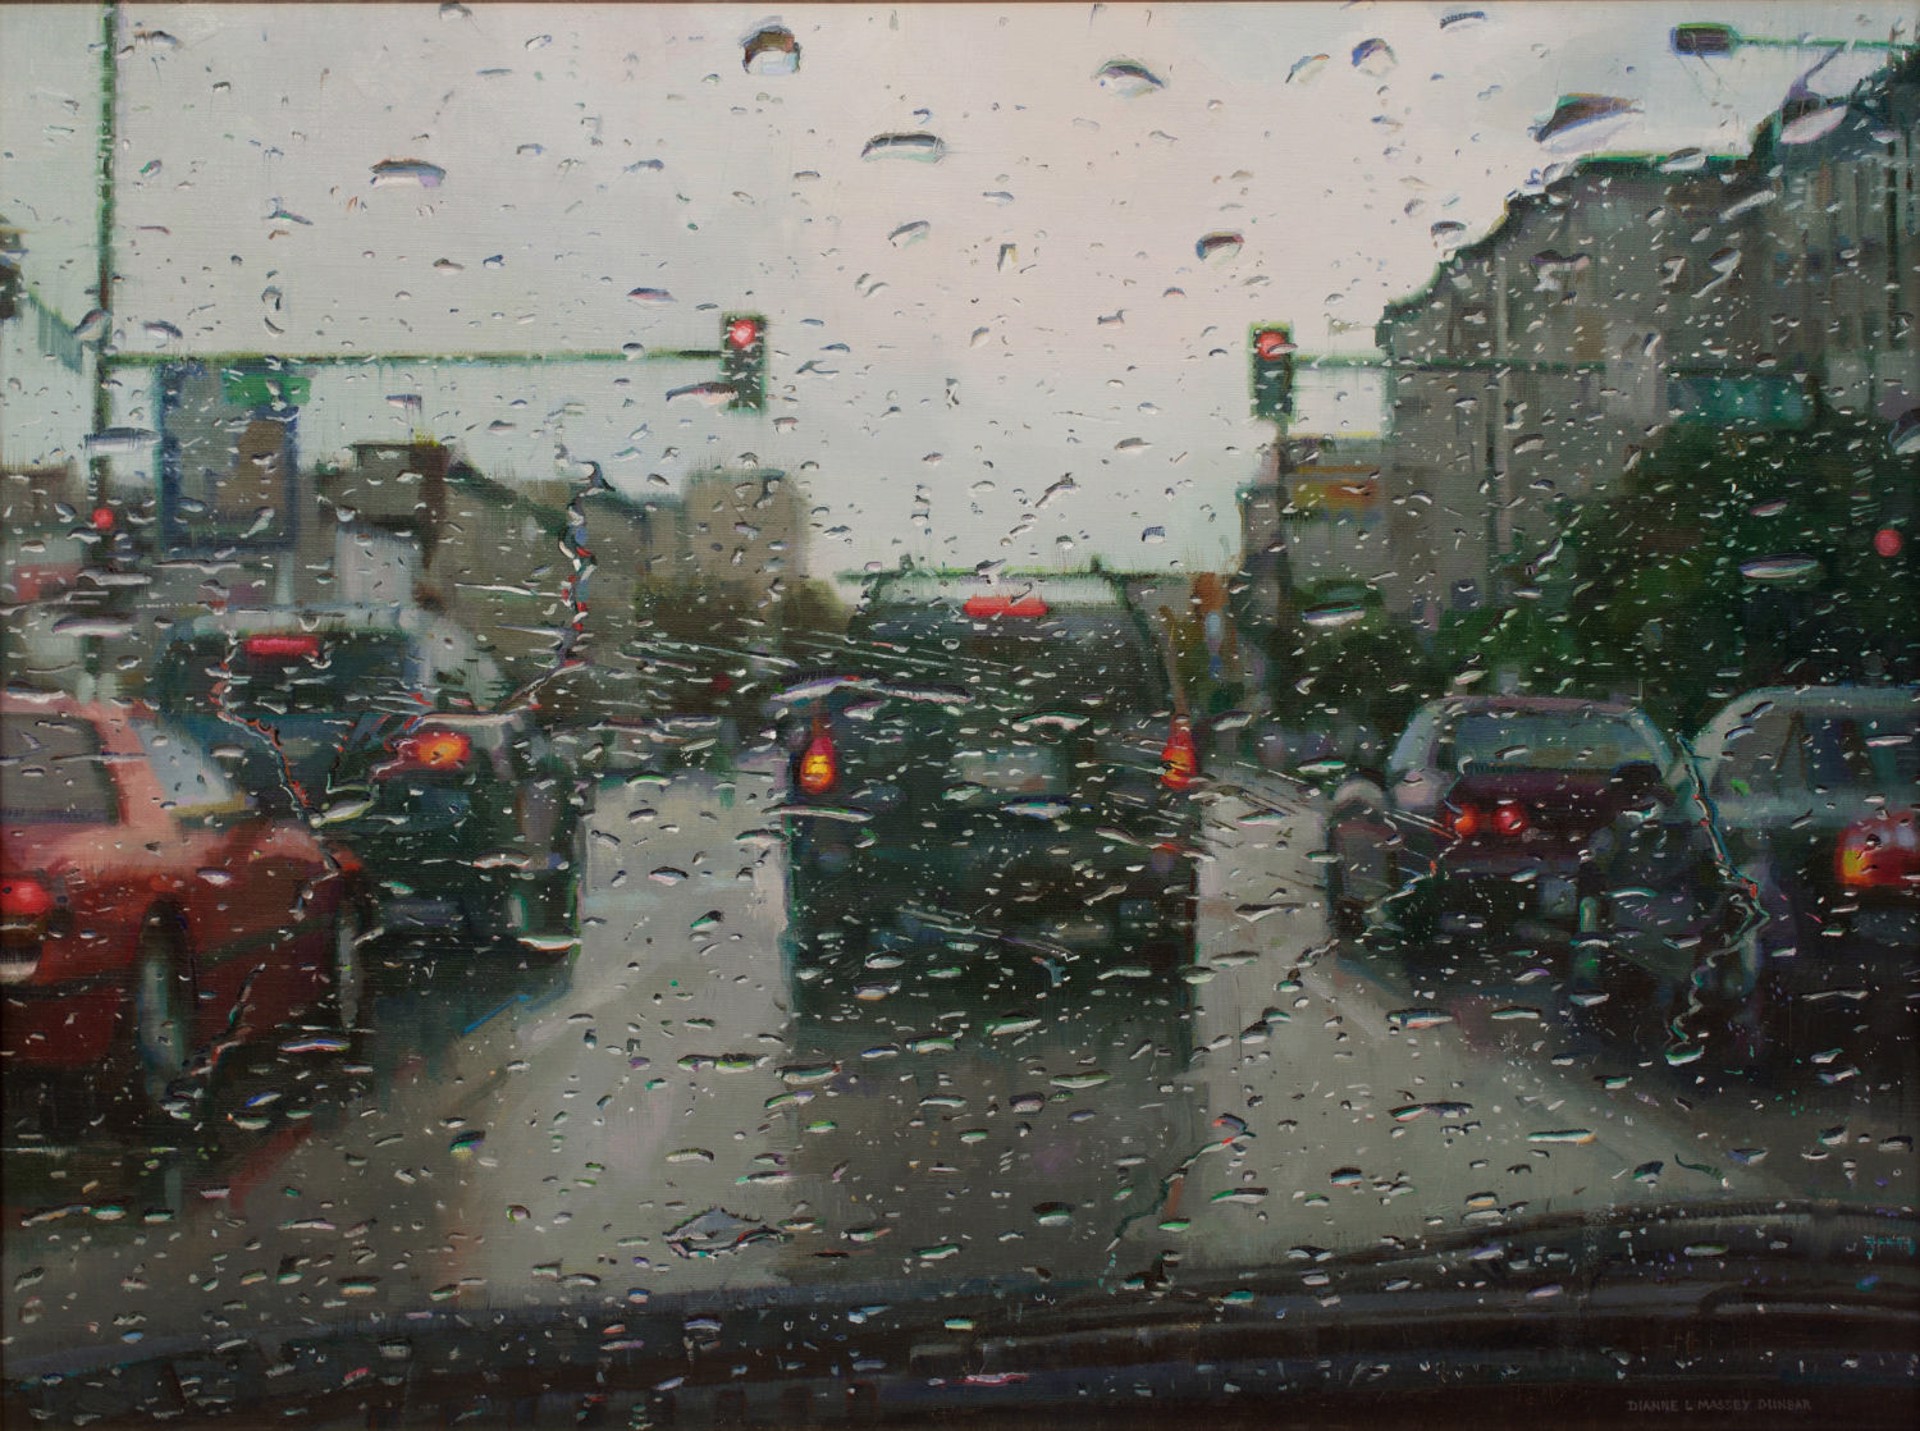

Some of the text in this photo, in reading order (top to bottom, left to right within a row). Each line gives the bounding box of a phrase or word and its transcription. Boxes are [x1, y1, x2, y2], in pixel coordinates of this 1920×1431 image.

[1627, 1398, 1813, 1412] DIANNE L MASSEY DUNBAR
